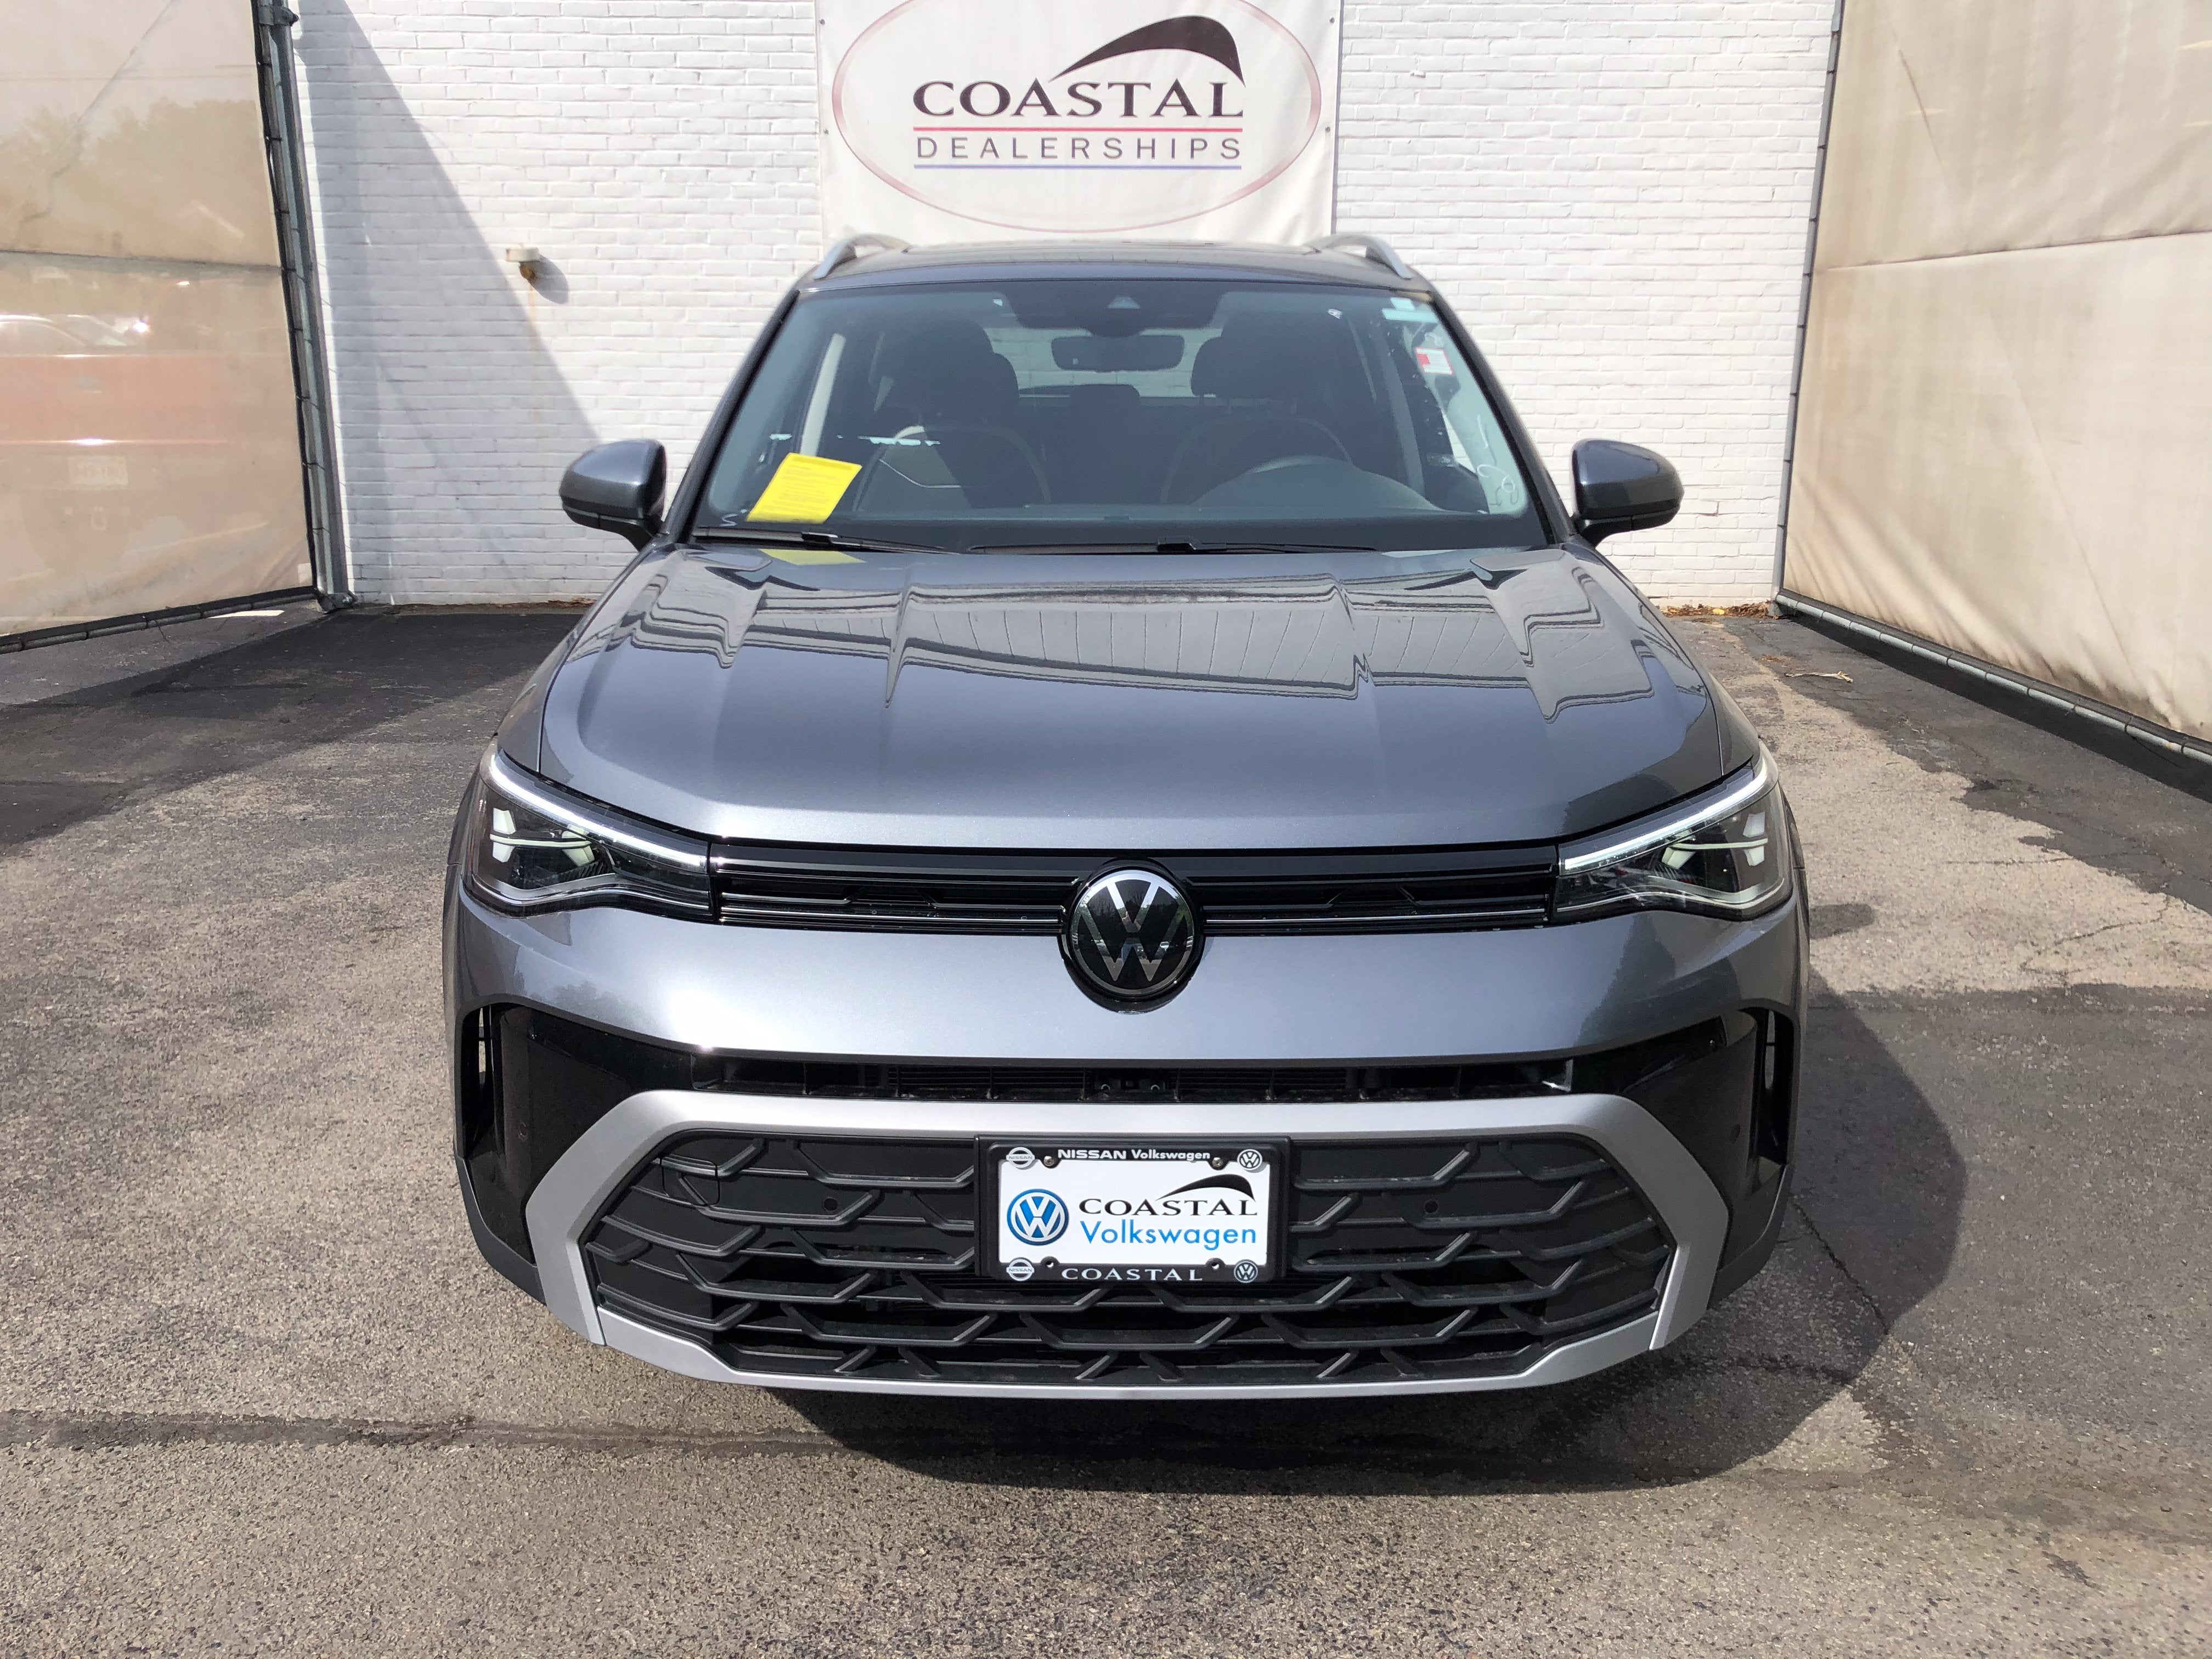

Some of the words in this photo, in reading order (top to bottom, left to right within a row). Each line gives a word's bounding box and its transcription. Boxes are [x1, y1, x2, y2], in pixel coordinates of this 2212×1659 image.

[913, 78, 1244, 117] COASTAL
[917, 138, 1241, 160] DEALERSHIPS
[1058, 1149, 1126, 1159] NISSAN
[1131, 1150, 1210, 1160] Volkswagen
[1079, 1198, 1257, 1216] COASTAL
[1080, 1219, 1256, 1251] Volkswagen
[1062, 1268, 1203, 1281] COASTAL
